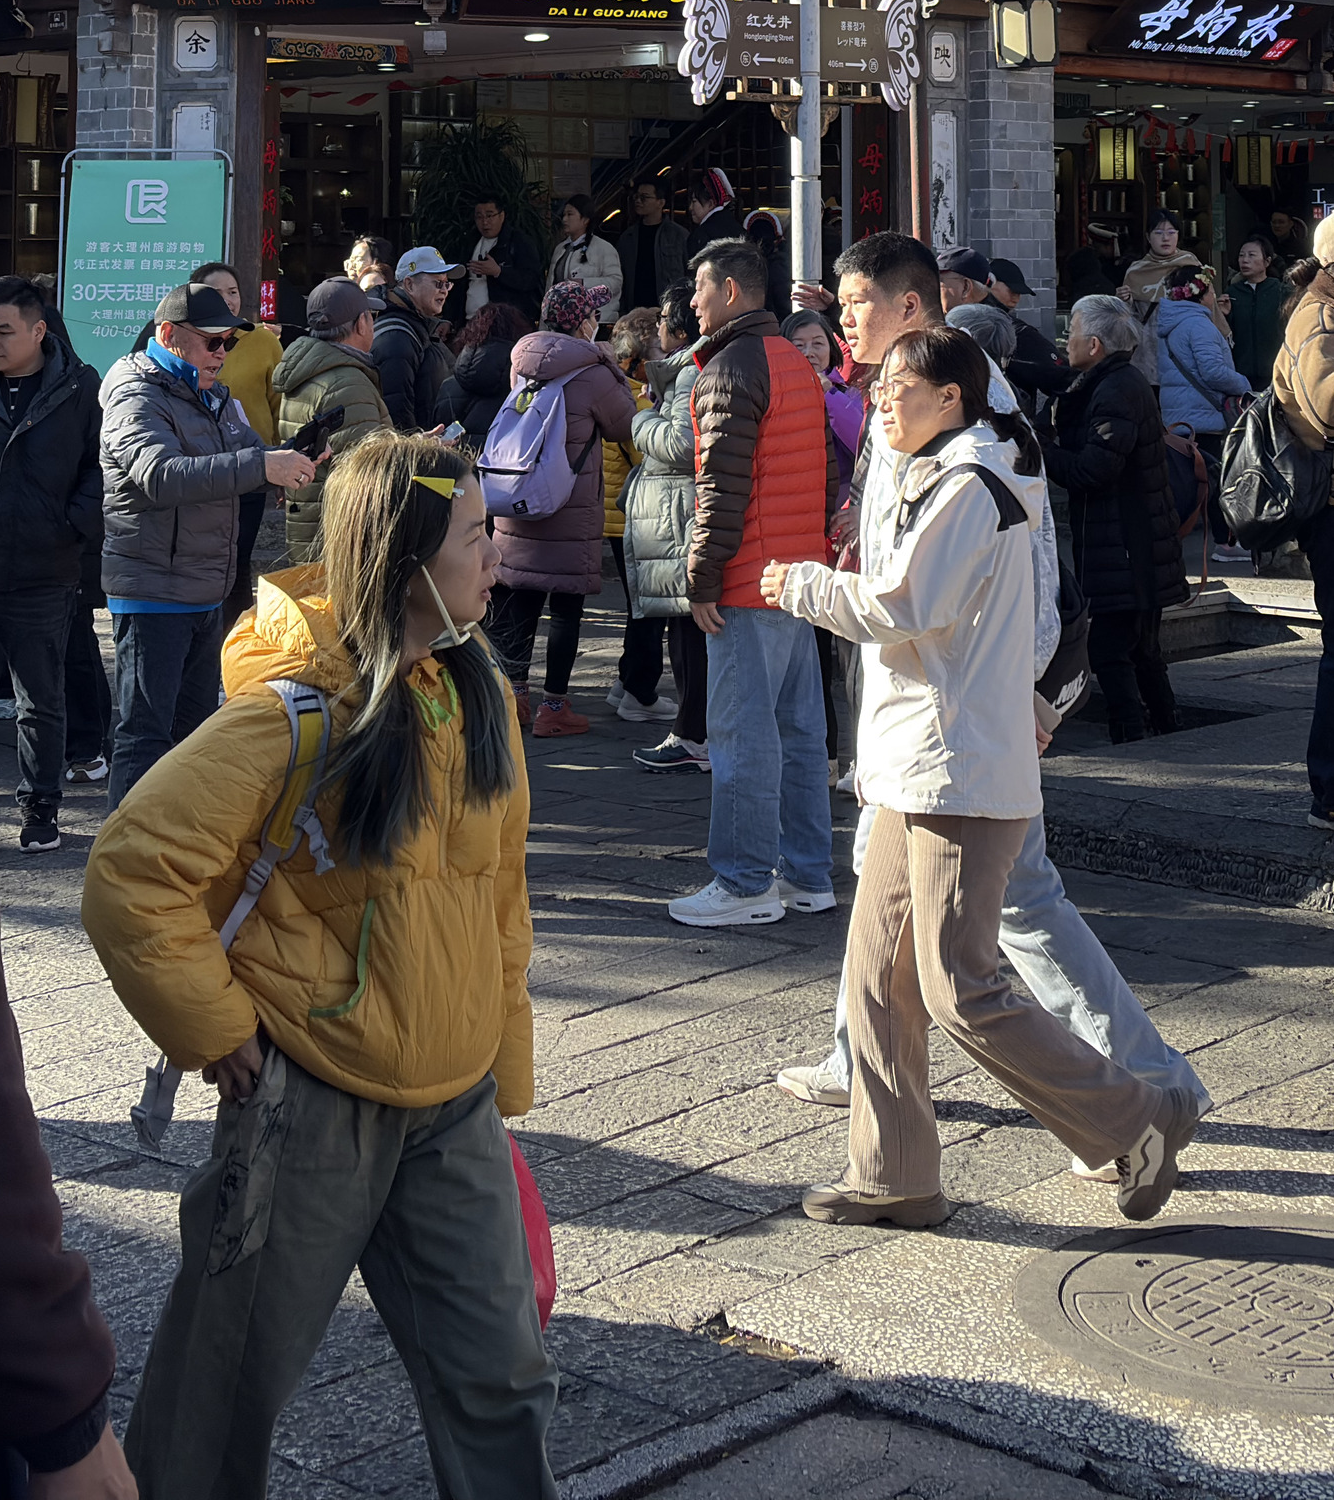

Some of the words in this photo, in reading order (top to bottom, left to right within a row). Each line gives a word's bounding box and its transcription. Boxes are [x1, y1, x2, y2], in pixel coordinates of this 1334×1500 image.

[548, 7, 567, 16] DA
[574, 8, 587, 17] LI
[593, 9, 623, 18] GUO
[625, 10, 668, 19] JIANG
[746, 13, 792, 30] 红龙井
[185, 30, 210, 54] 余
[744, 32, 778, 43] Honglongjing
[779, 33, 794, 42] Street
[1128, 40, 1143, 50] Mu
[1142, 41, 1162, 52] Bing
[1161, 42, 1175, 52] Lin
[1175, 44, 1216, 54] Handmade
[1215, 46, 1251, 58] Workshop
[777, 56, 794, 65] 406m
[934, 44, 951, 68] 映
[828, 60, 844, 68] 406m
[86, 241, 205, 254] 游客大理州旅游购物
[74, 259, 135, 270] 凭正式发票
[71, 283, 181, 302] 30天无理由
